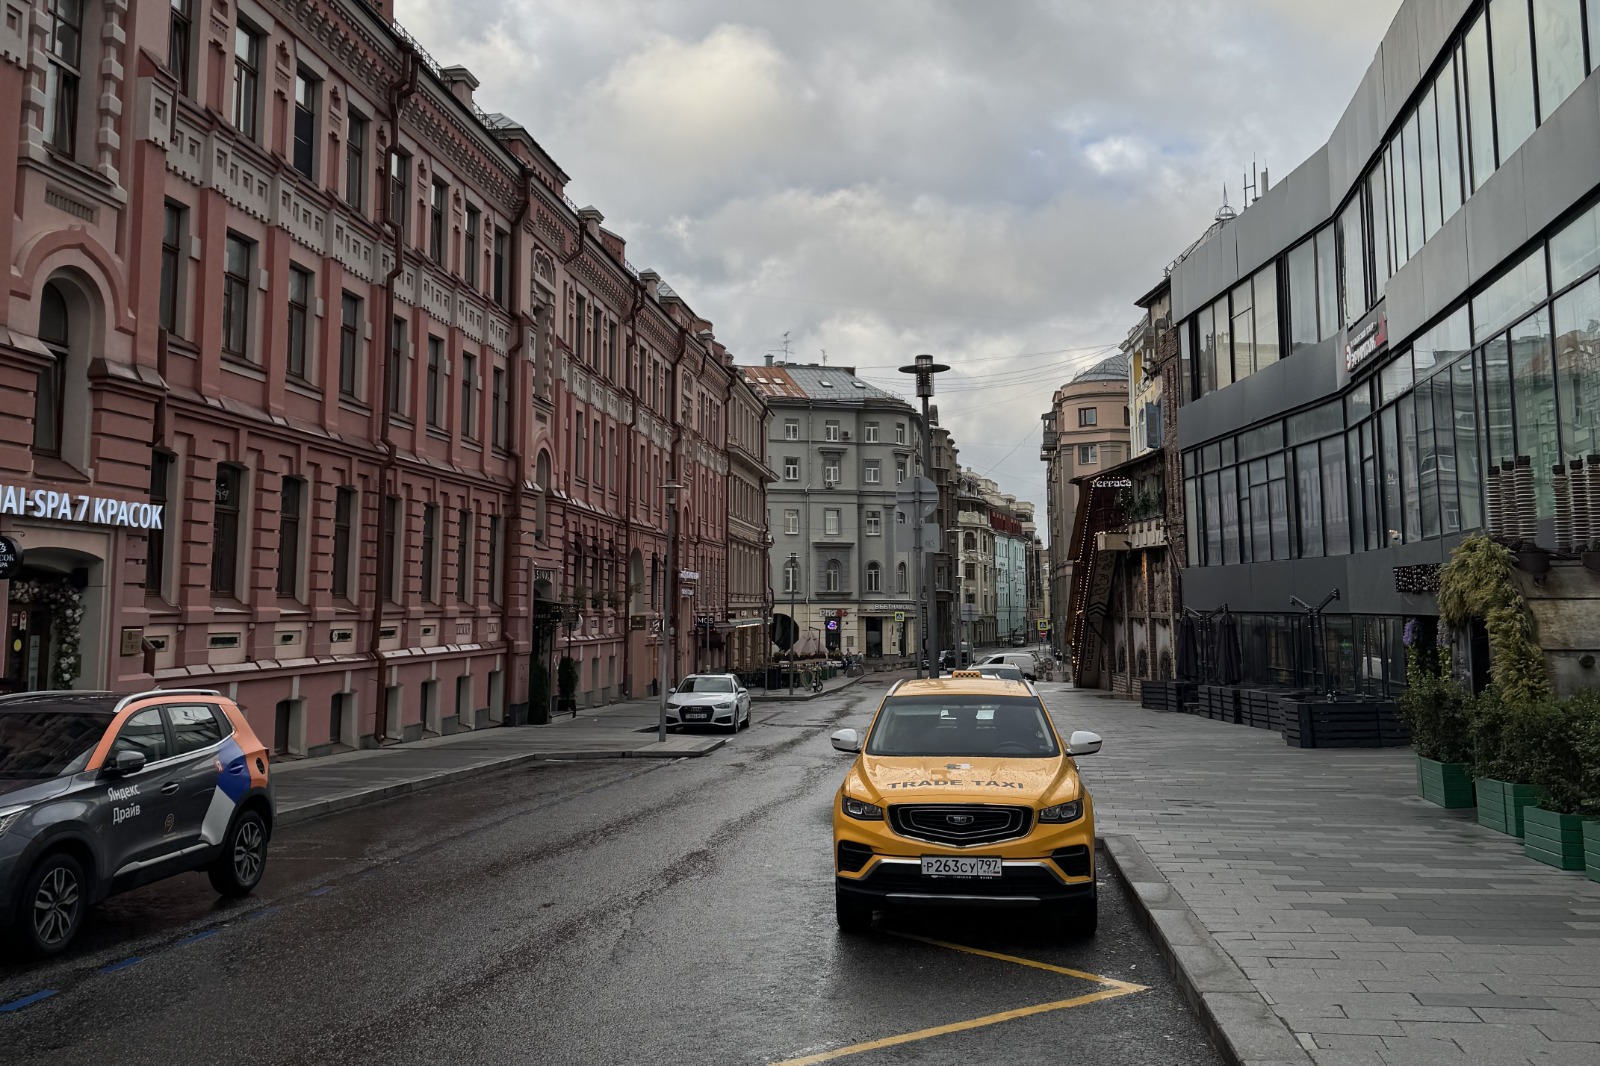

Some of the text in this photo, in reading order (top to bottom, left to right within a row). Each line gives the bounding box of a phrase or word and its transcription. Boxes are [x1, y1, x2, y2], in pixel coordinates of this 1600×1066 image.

[0, 485, 163, 530] AI-SPA 7 КРАСОК
[888, 779, 1024, 789] TRADE TAXI
[107, 785, 141, 802] Яндекс
[112, 802, 141, 826] Драйв
[979, 860, 998, 870] 797
